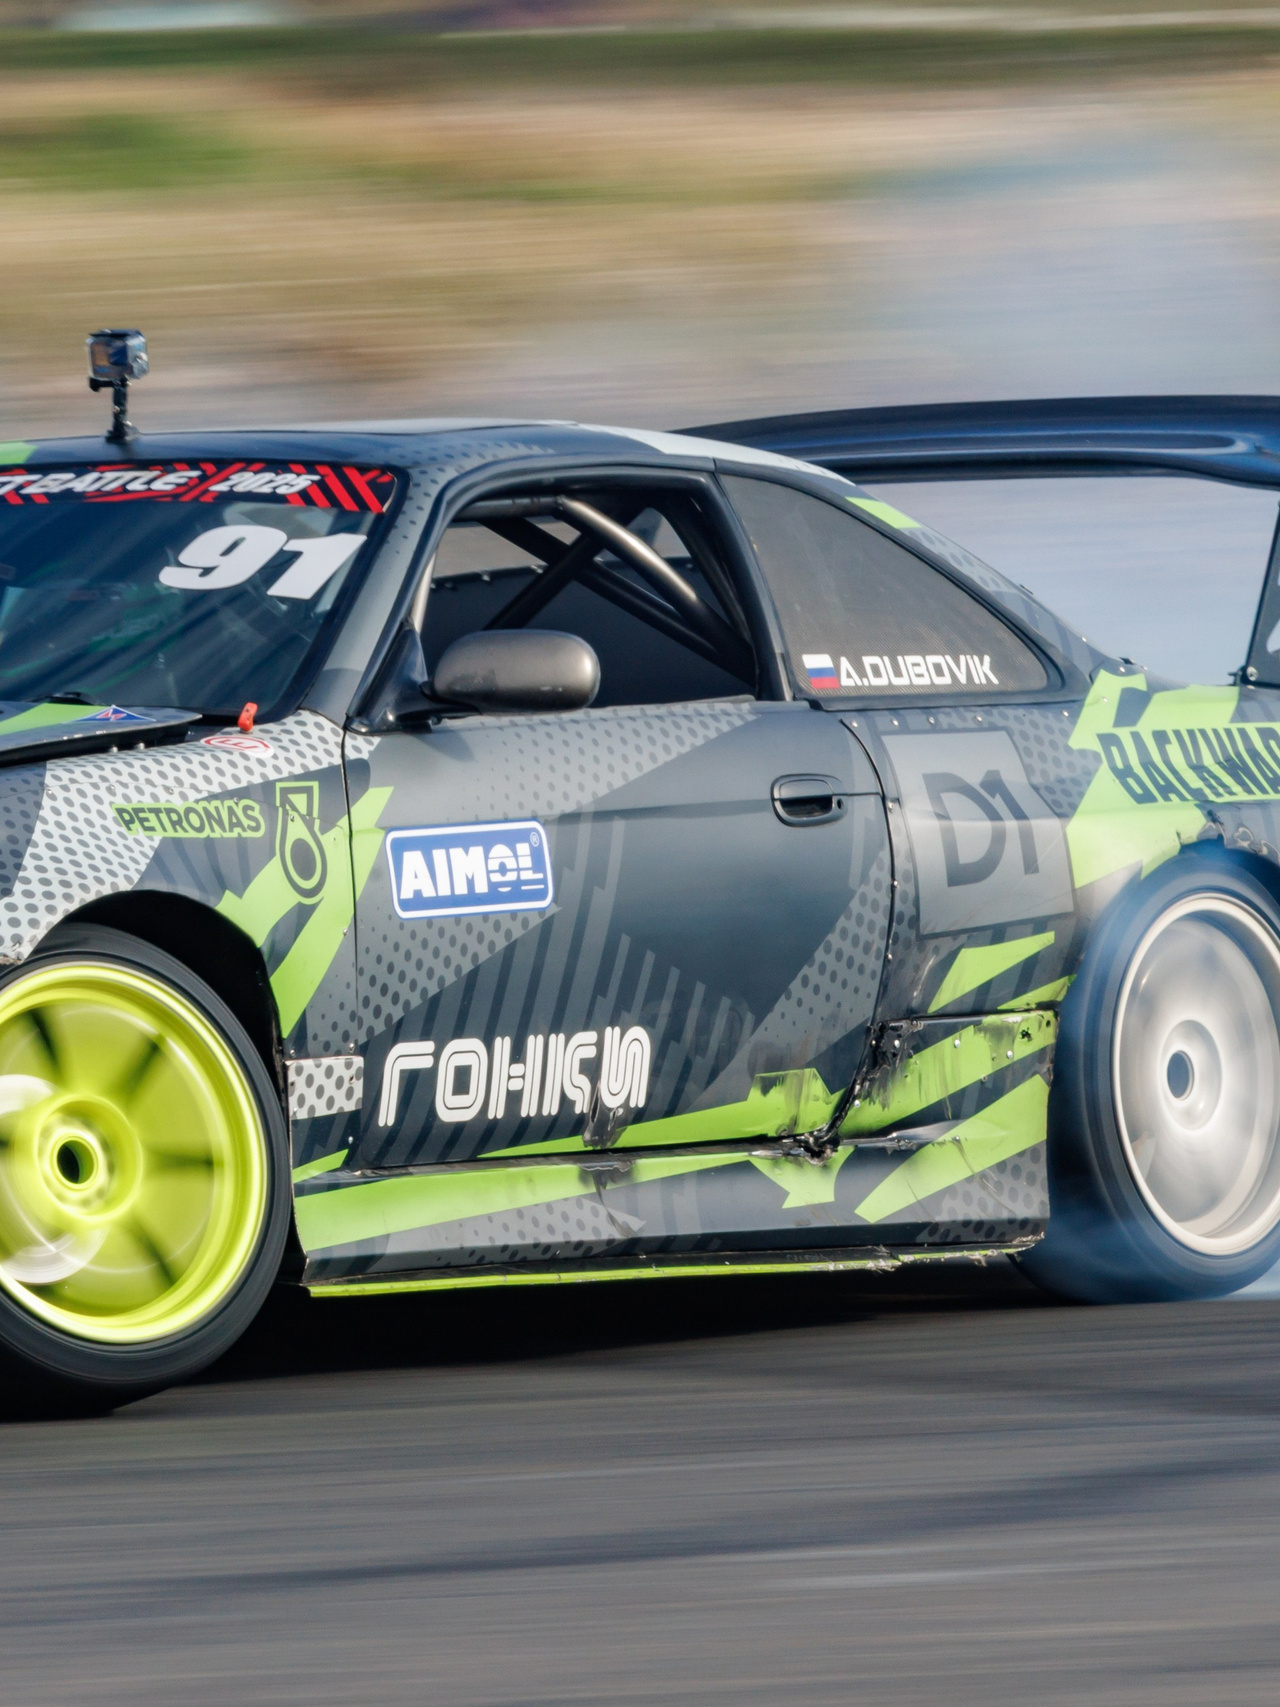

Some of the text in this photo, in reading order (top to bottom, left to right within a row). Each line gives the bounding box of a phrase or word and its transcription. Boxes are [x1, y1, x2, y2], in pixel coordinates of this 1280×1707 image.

[20, 470, 203, 494] BATTLE
[207, 471, 322, 495] 2025
[158, 524, 368, 600] 91
[840, 654, 999, 686] A.DUBOVIK
[114, 803, 263, 835] PETRONAS
[922, 769, 1040, 888] D1
[400, 842, 545, 900] AIMOL
